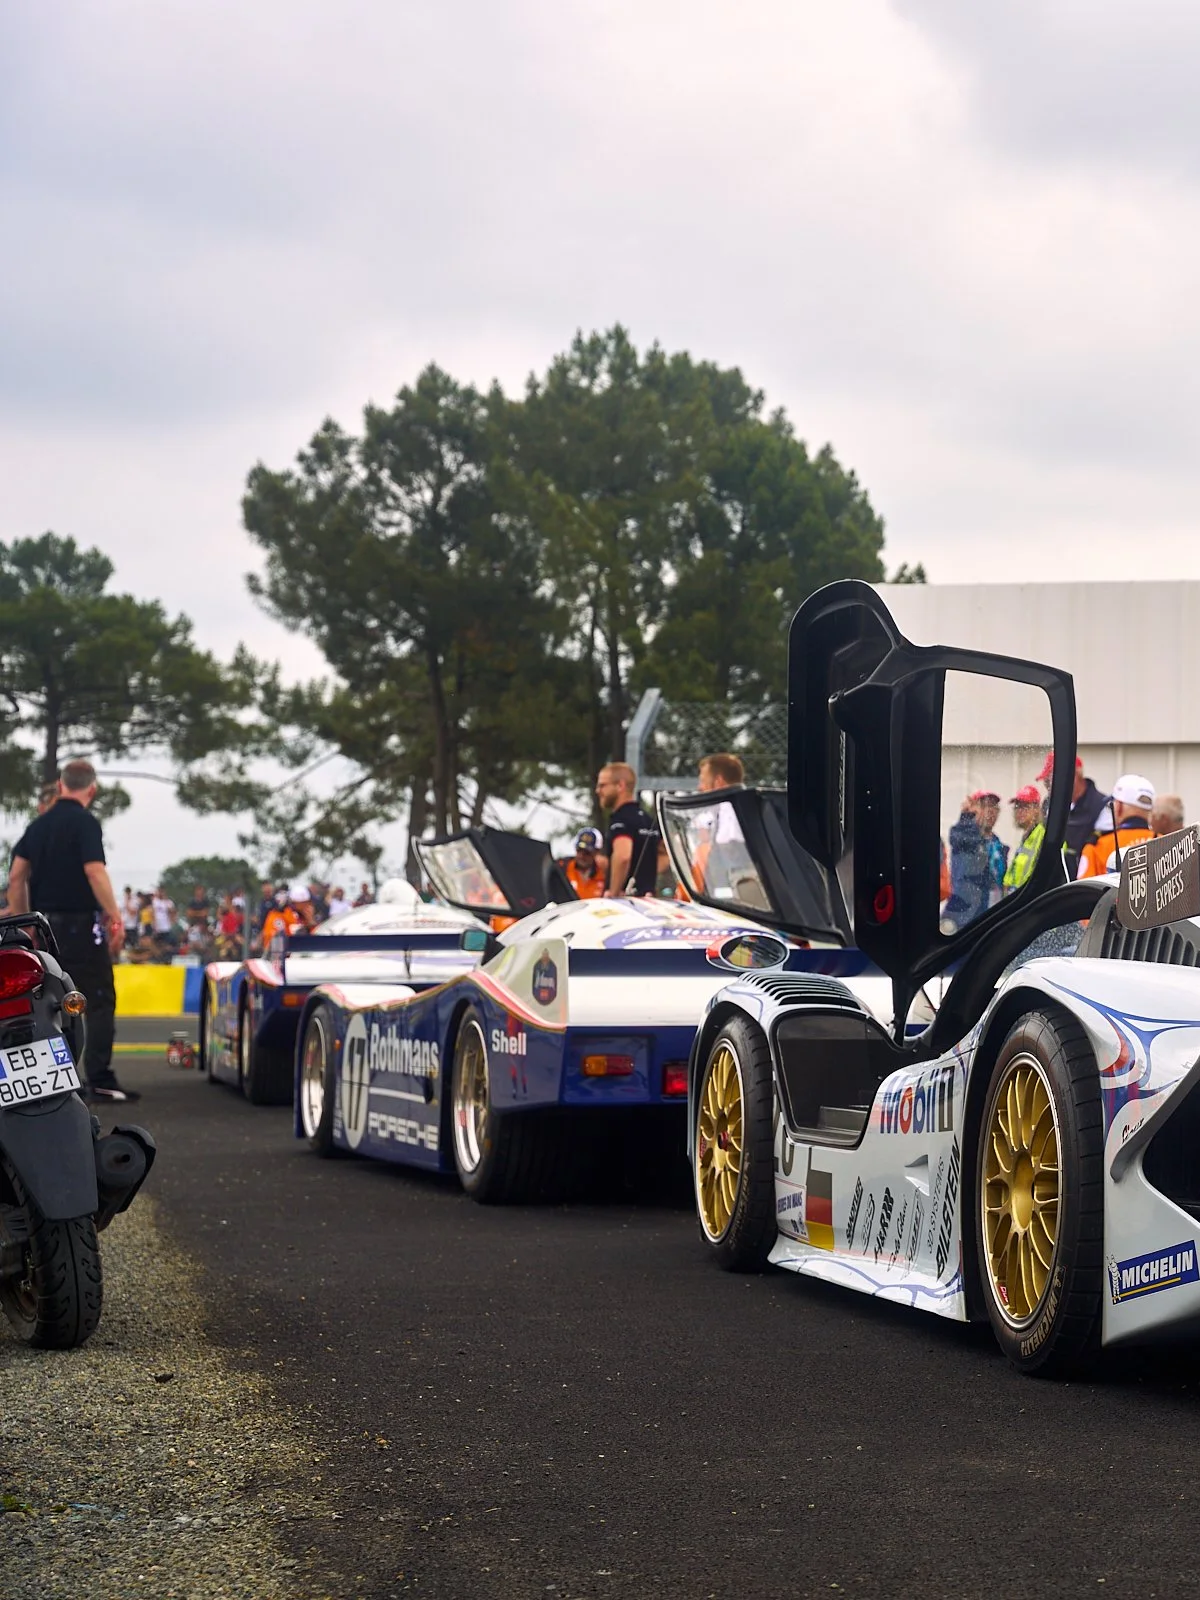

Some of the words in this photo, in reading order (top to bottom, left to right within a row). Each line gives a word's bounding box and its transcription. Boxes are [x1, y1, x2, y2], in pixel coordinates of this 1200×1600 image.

[1153, 830, 1196, 884] WORLDWIDE
[1129, 872, 1146, 908] ups
[1155, 869, 1184, 912] EXPRESS
[369, 1022, 439, 1078] Rothmans
[491, 1029, 527, 1056] Shell
[0, 1066, 75, 1103] 806-ZT
[368, 1111, 439, 1151] PORSCHE
[936, 1133, 960, 1281] BILSTEIN
[1122, 1249, 1194, 1290] MICHELIN
[1021, 1290, 1059, 1357] MICHELIN
